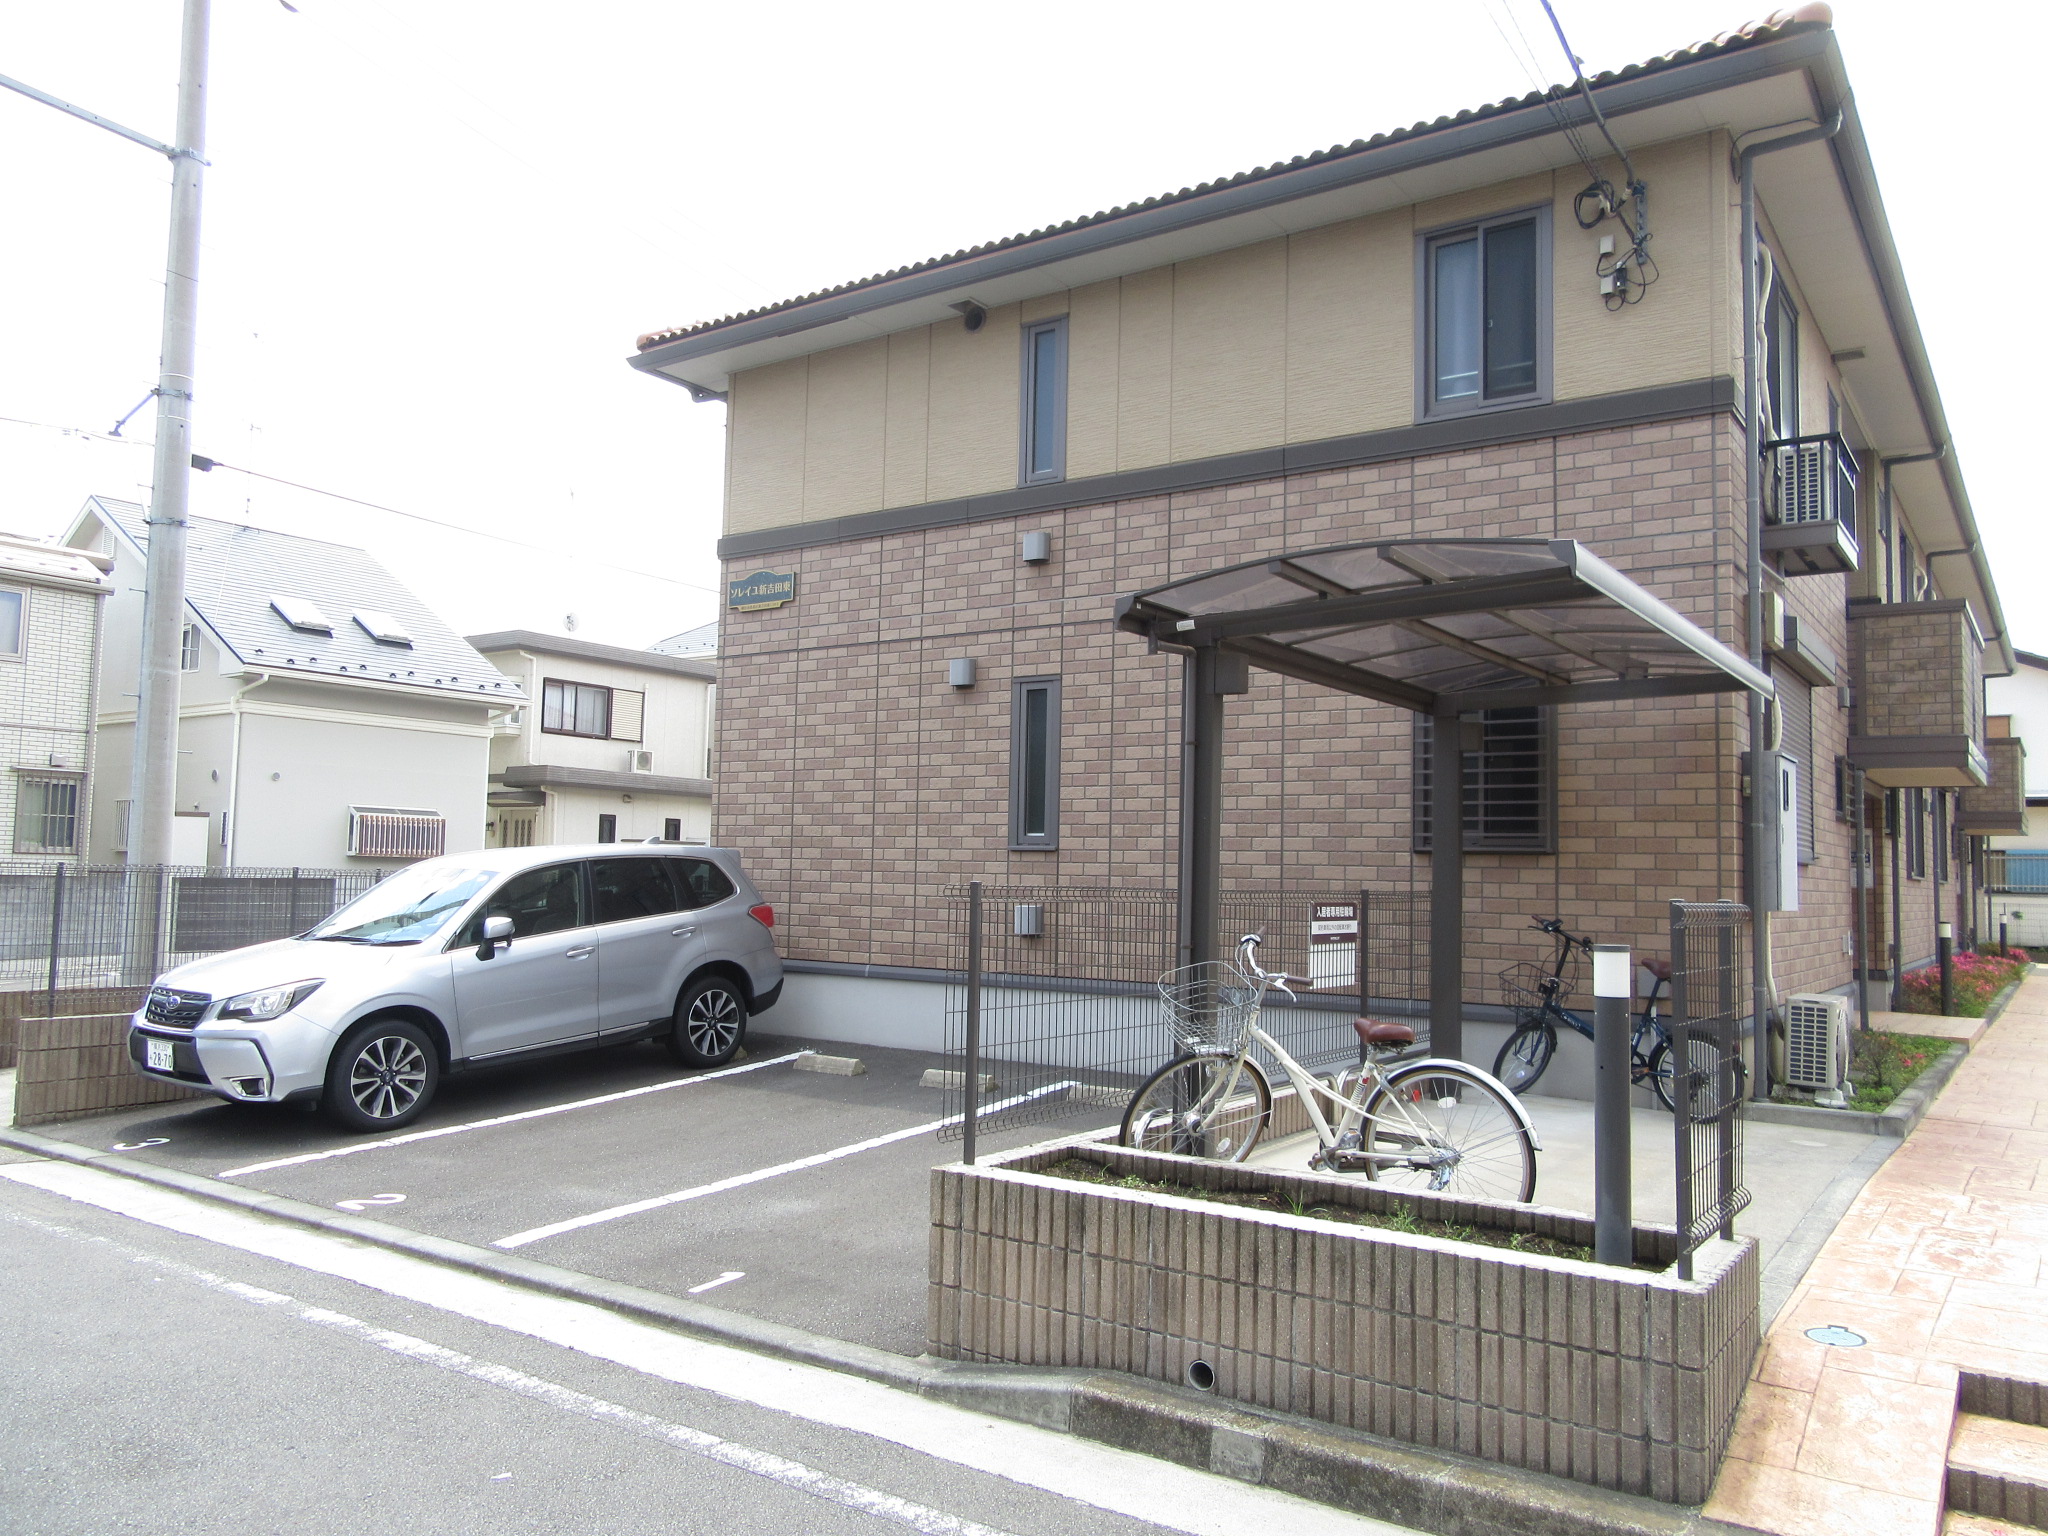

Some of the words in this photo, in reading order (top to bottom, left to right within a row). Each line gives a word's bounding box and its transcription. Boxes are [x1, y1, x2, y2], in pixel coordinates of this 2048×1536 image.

[730, 581, 791, 599] ソレイユ新吉田東
[113, 1137, 170, 1151] 3
[335, 1193, 407, 1211] 2
[687, 1271, 746, 1294] 1
